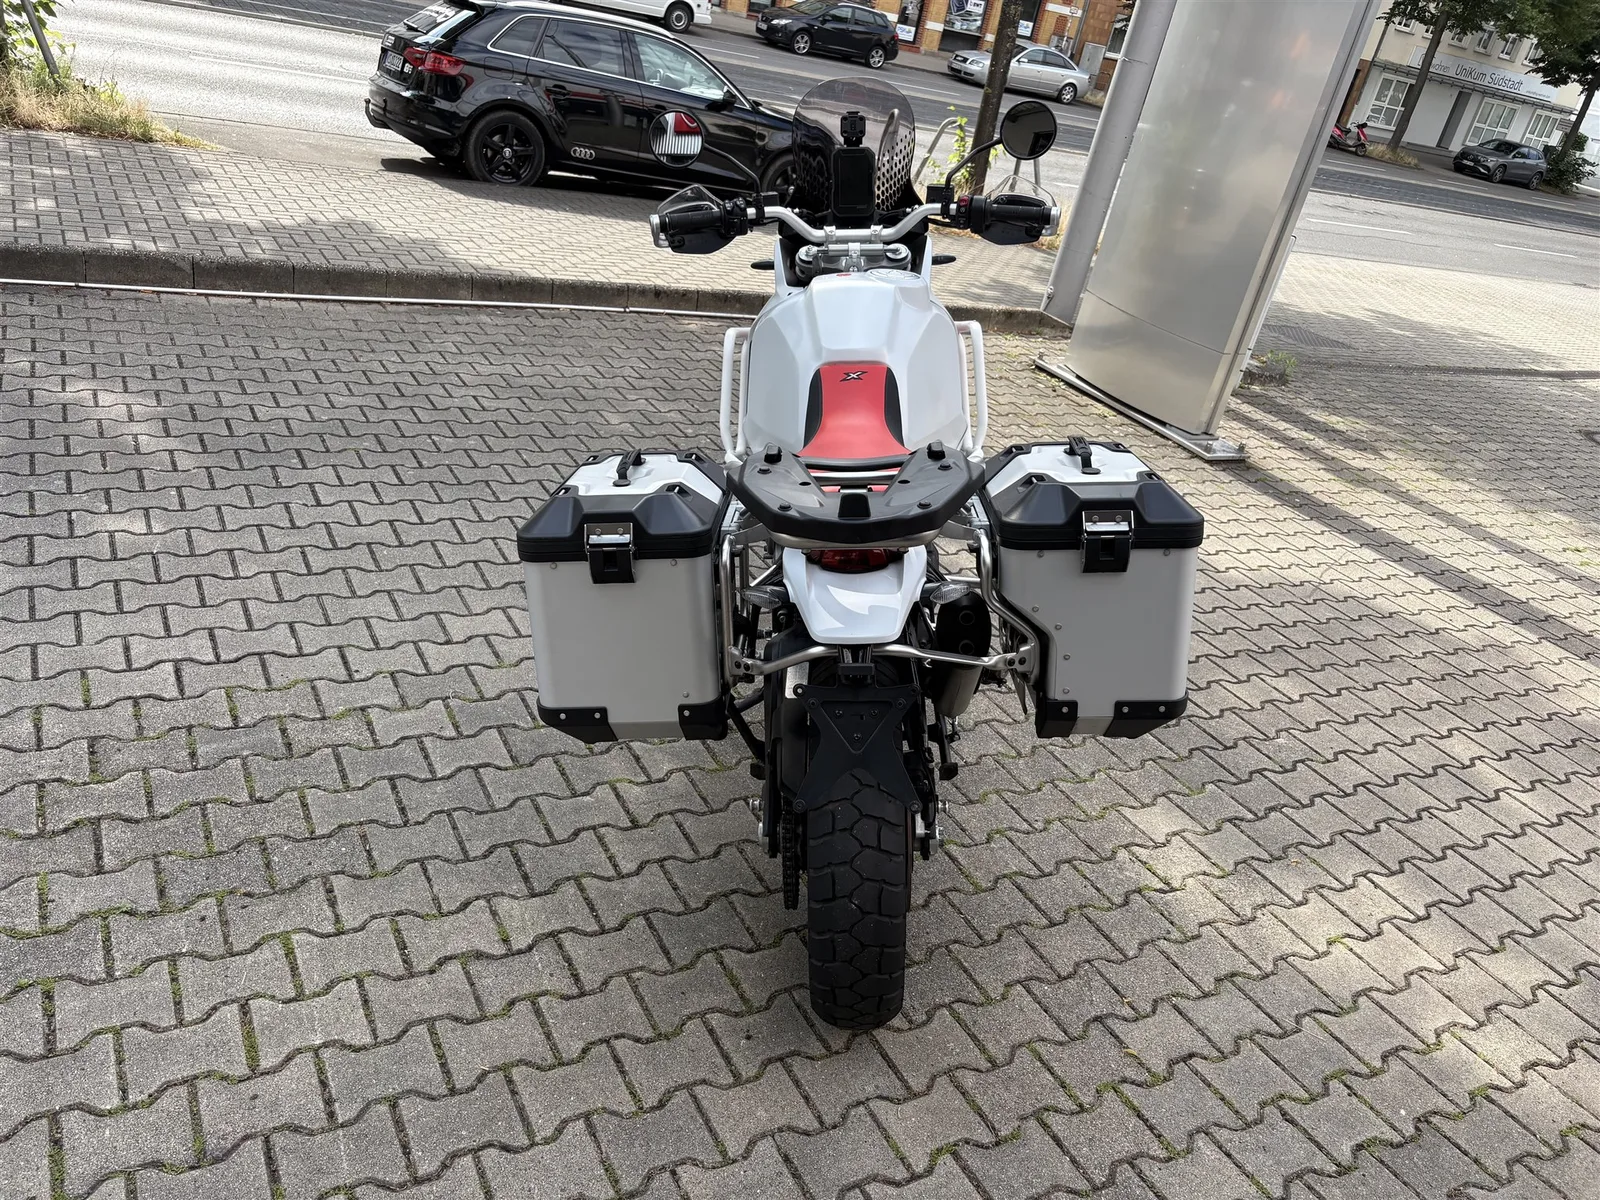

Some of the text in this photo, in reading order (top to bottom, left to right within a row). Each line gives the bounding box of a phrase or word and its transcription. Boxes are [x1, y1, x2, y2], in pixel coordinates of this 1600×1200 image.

[1455, 64, 1487, 82] UniKum
[1488, 73, 1523, 91] Südstadt
[840, 370, 868, 382] X
